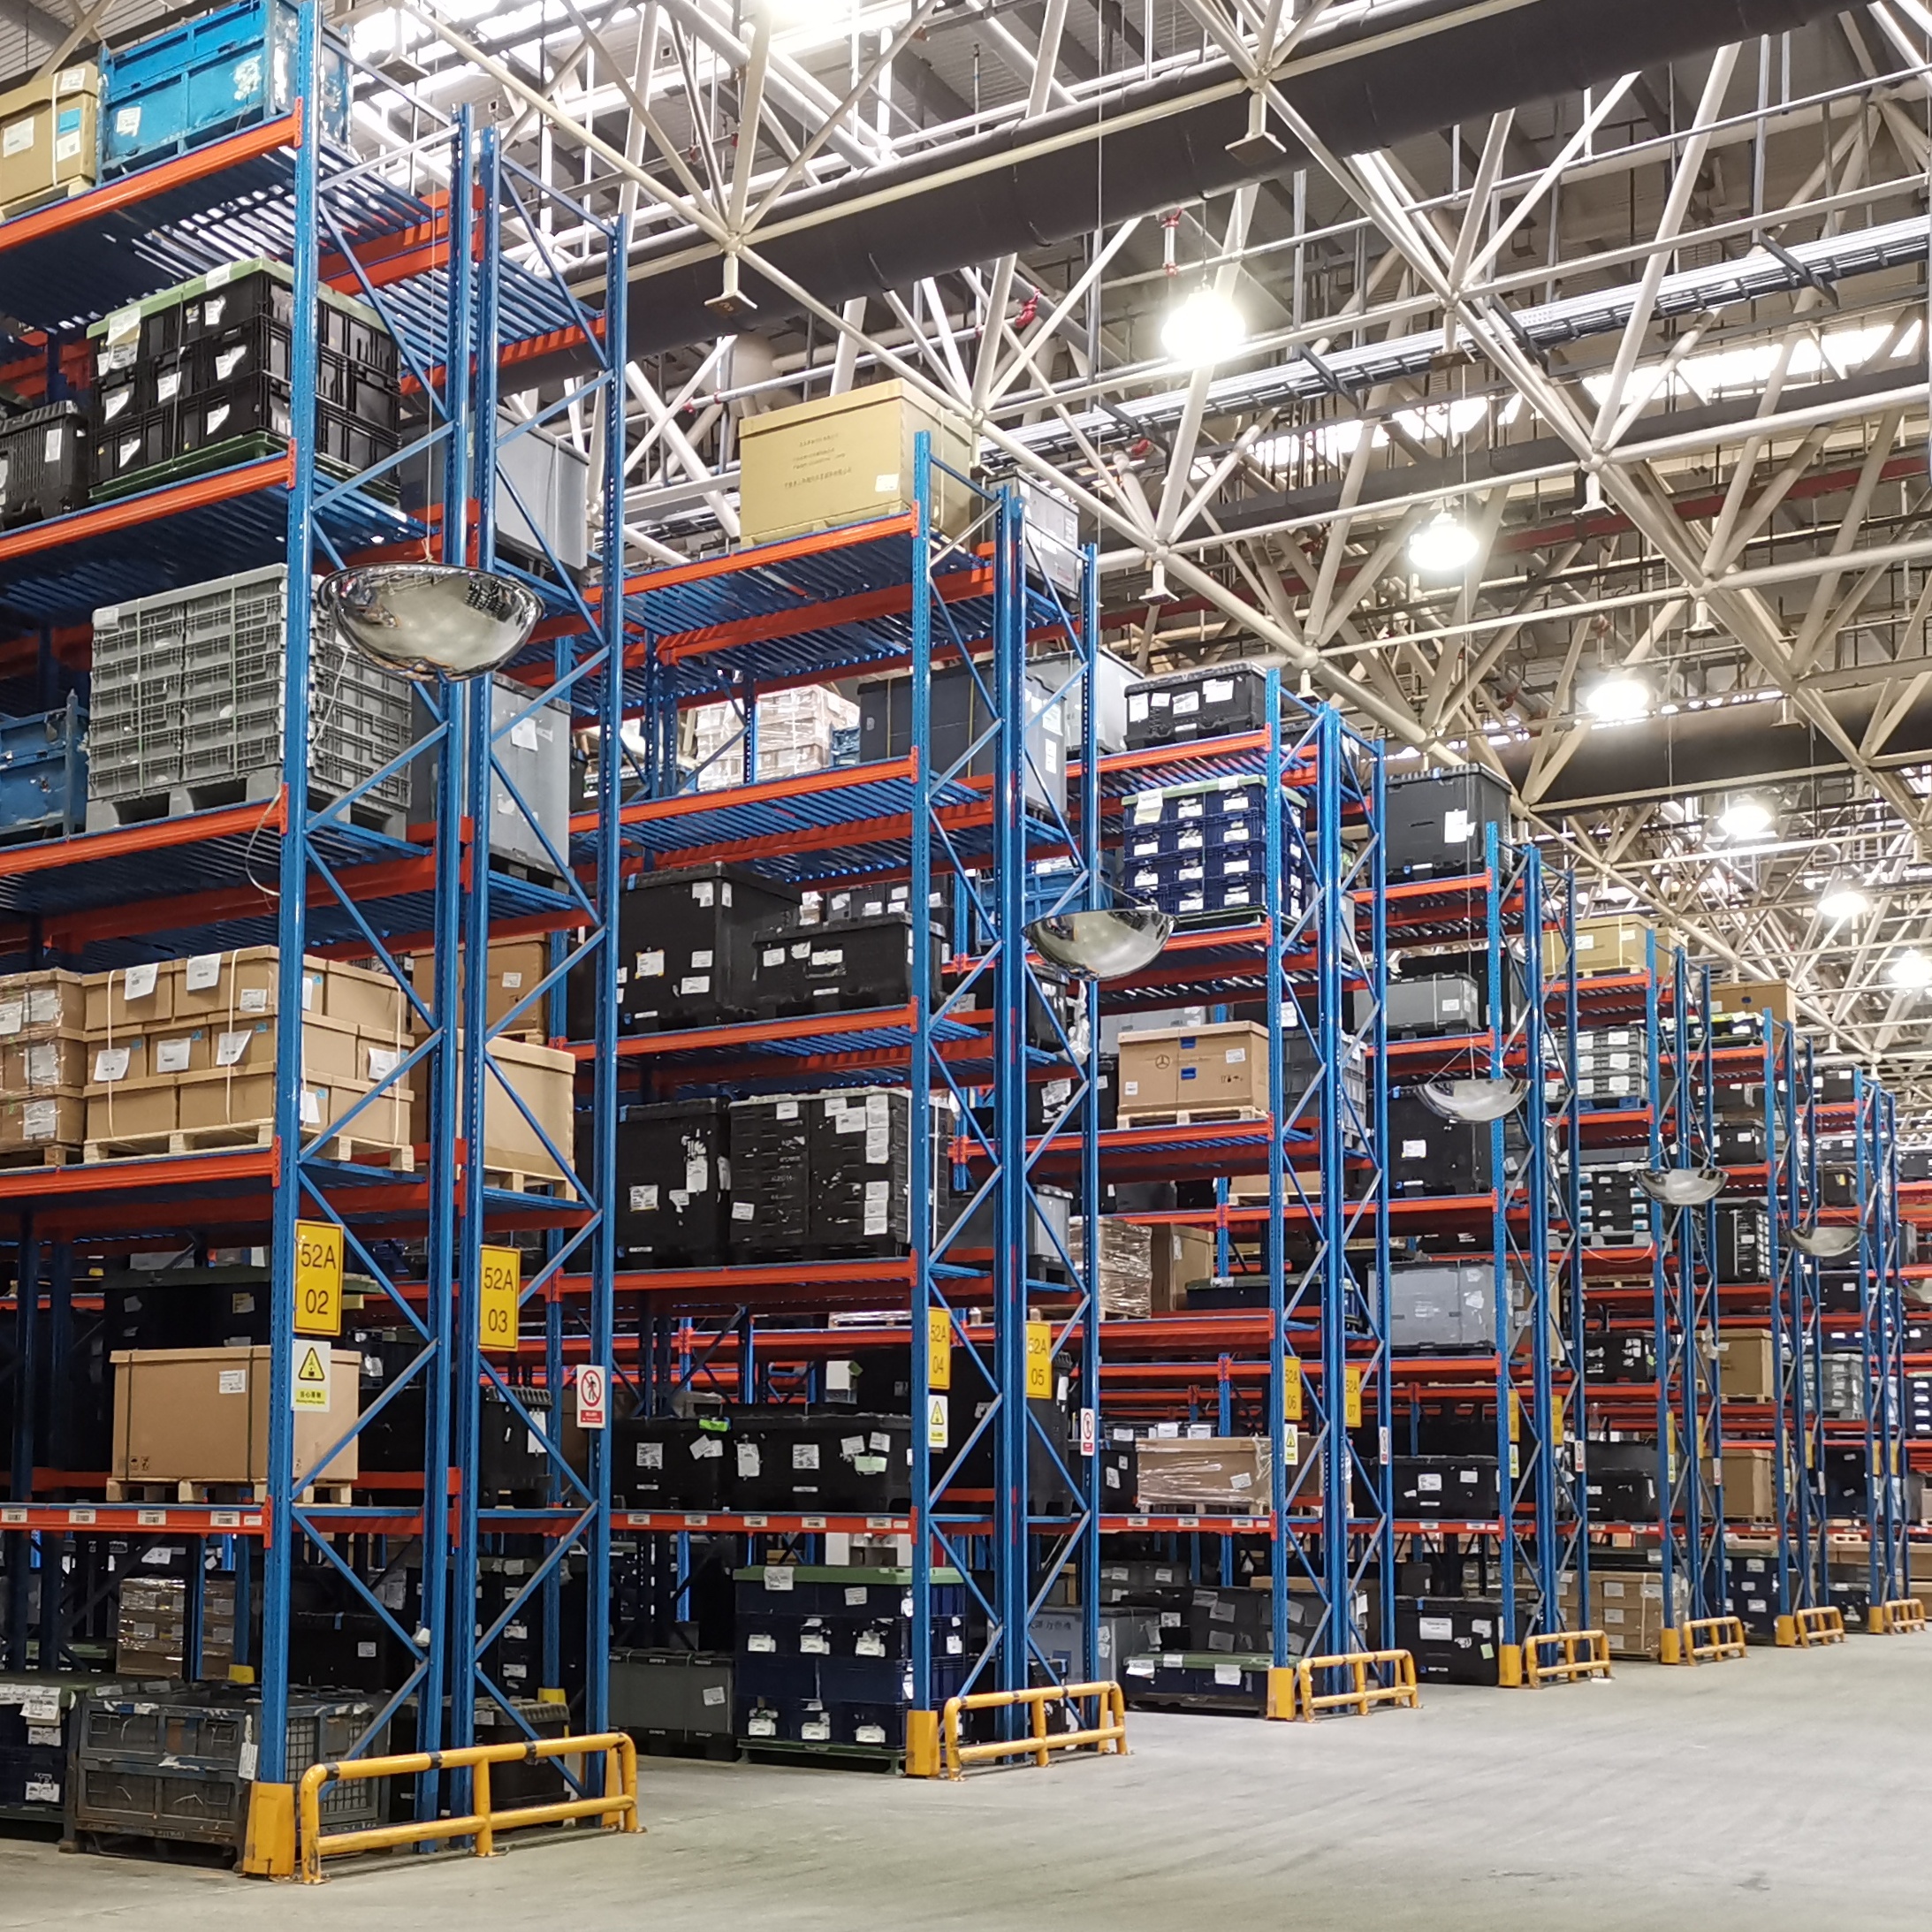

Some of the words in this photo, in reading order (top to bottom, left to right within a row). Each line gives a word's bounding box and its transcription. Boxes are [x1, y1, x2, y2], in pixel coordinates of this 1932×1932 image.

[300, 1243, 337, 1270] 52A
[483, 1266, 514, 1291] 52A
[305, 1289, 329, 1315] 02
[488, 1308, 508, 1333] 03
[931, 1324, 947, 1343] 52A
[1028, 1337, 1048, 1355] 52A
[932, 1355, 945, 1374] 04
[1031, 1367, 1045, 1386] 05
[1287, 1394, 1297, 1410] 06
[1347, 1403, 1357, 1418] 07
